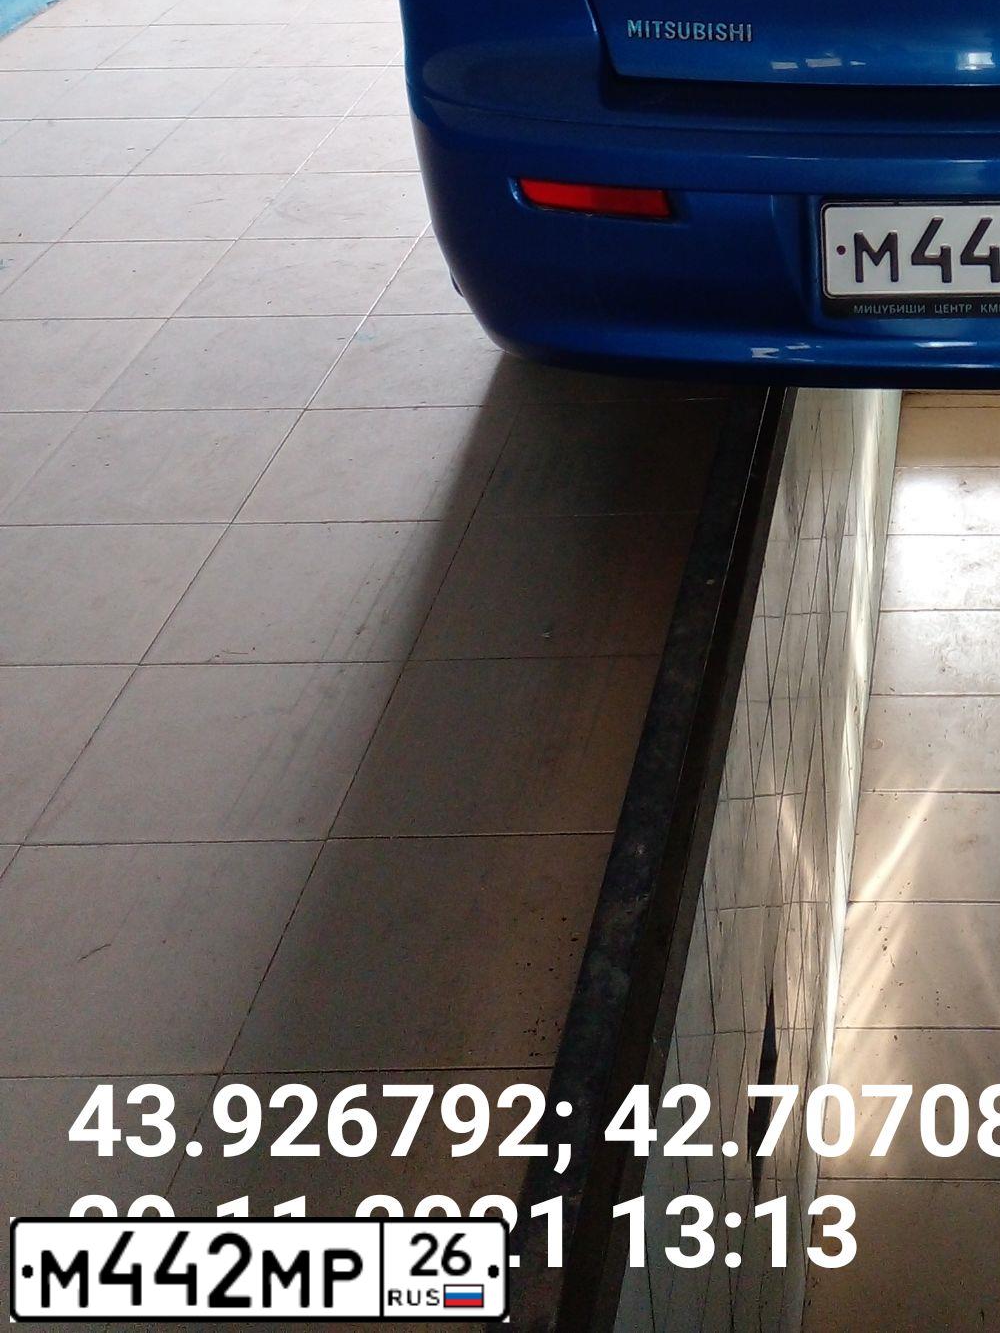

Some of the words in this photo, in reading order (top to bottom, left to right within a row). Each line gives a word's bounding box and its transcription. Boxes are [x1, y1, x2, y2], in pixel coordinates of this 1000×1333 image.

[626, 19, 752, 42] MITSUBISHI
[853, 304, 926, 315] МИЦУБИШИ
[934, 304, 972, 315] ЦЕНТР
